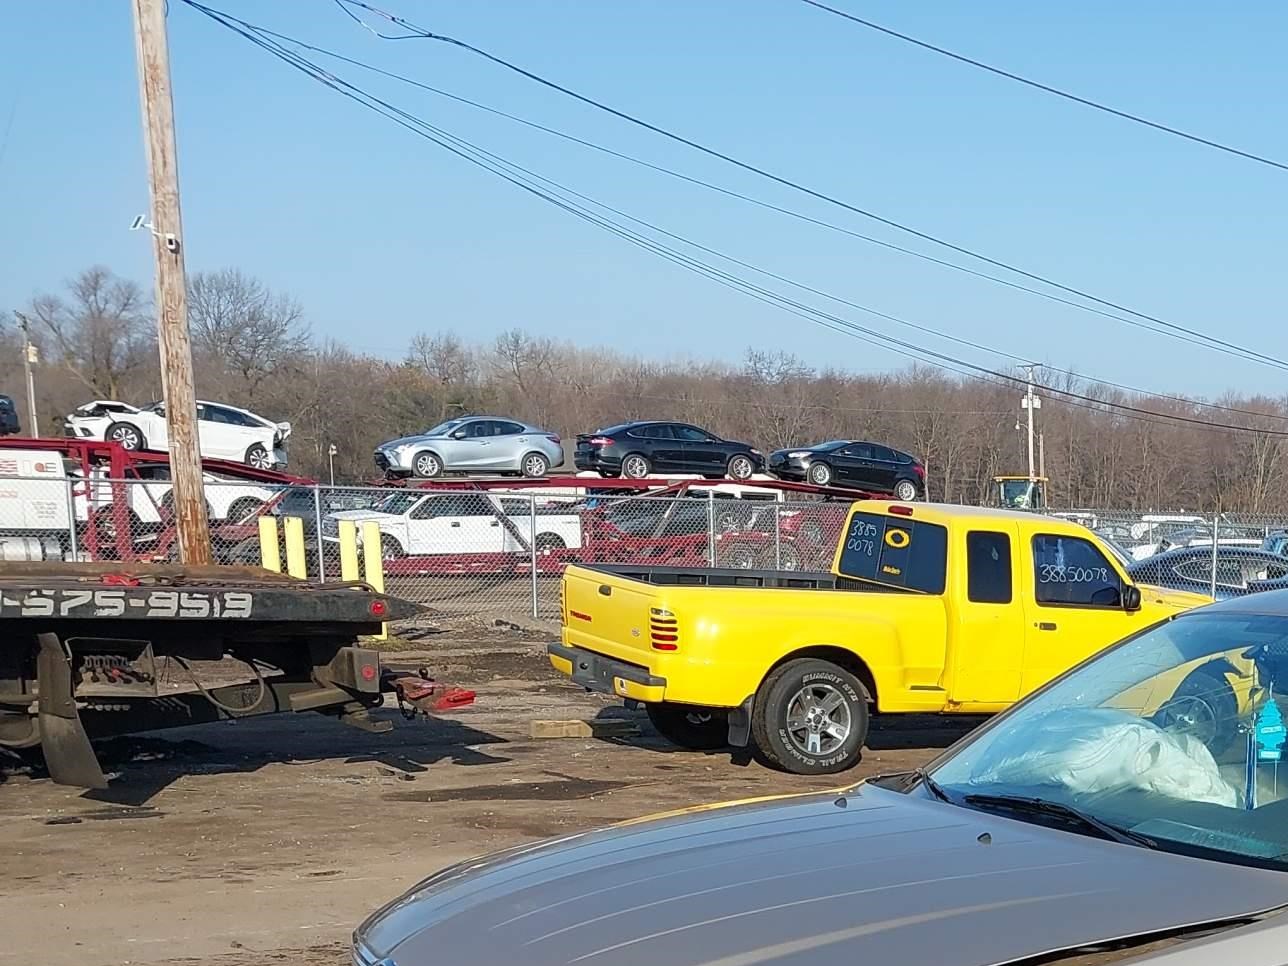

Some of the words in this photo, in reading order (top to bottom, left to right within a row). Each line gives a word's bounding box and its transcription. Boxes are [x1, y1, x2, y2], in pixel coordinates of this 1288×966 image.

[851, 520, 877, 536] 3885
[847, 538, 874, 556] 0078
[1039, 563, 1108, 583] 38850078
